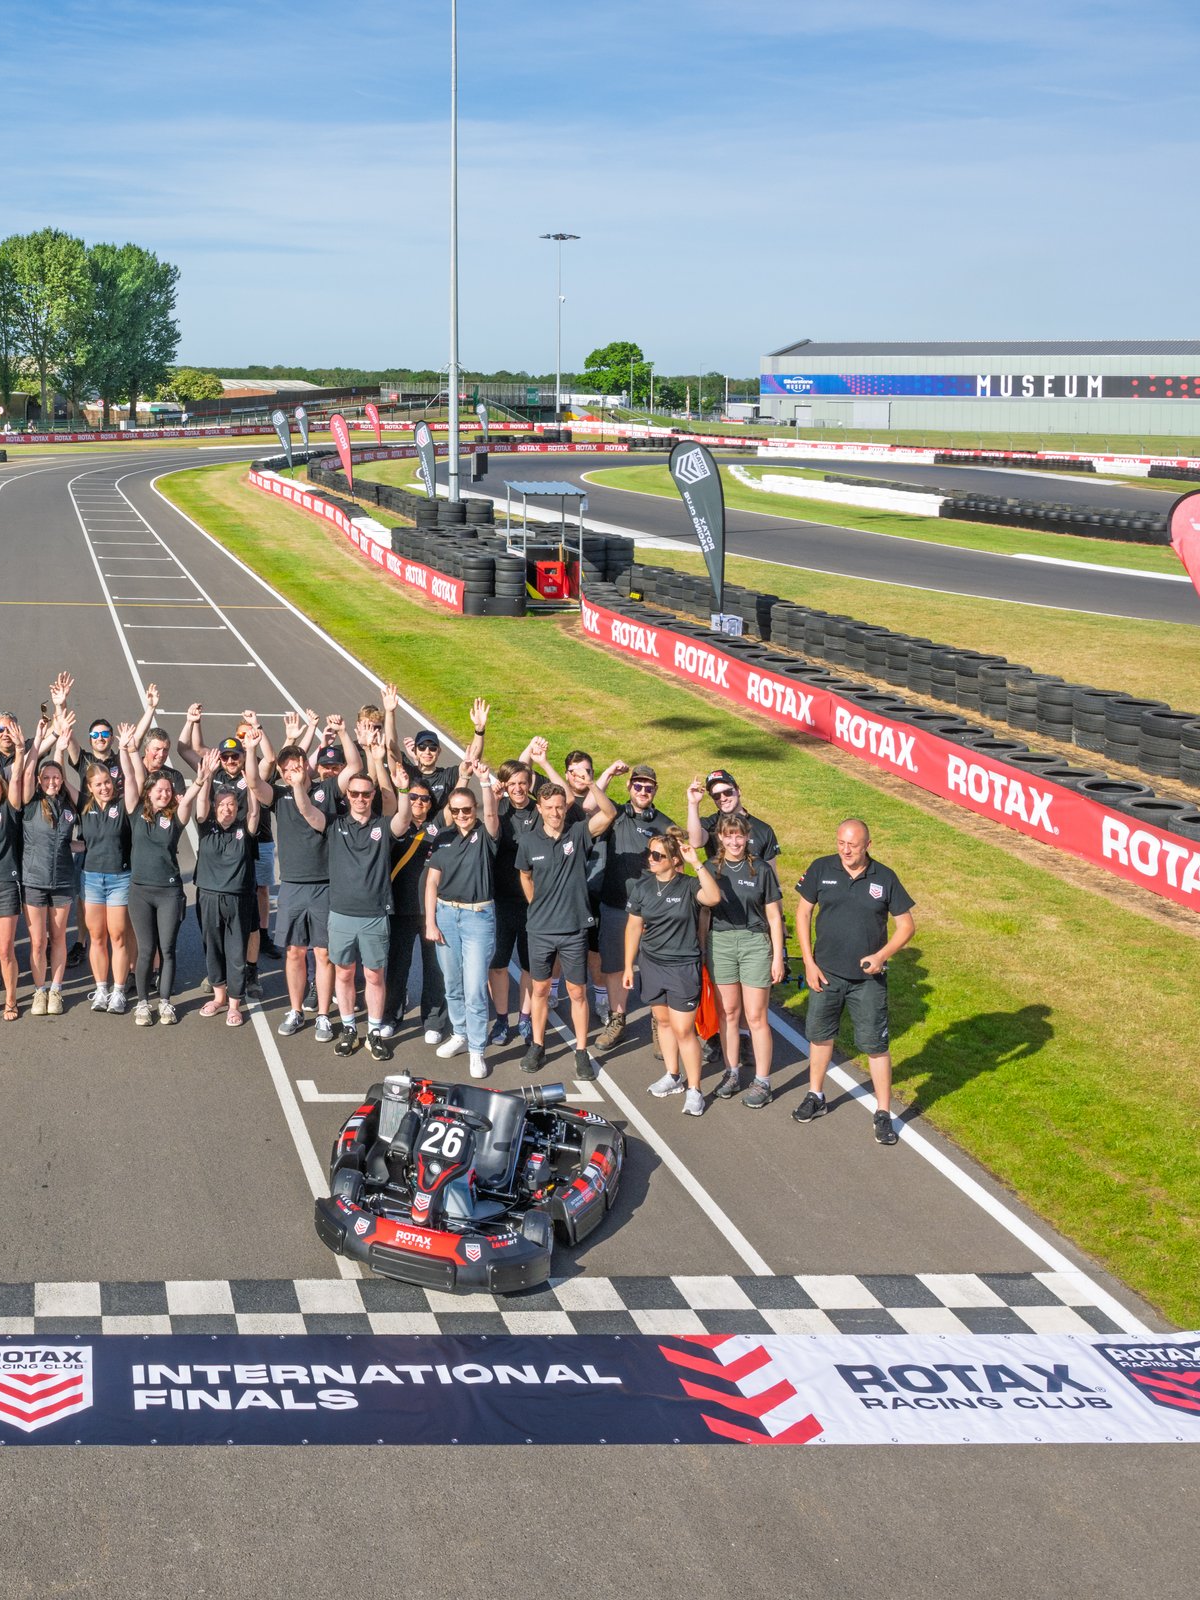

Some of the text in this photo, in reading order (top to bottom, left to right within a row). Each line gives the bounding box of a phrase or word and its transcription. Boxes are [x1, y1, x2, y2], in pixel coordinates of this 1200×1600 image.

[976, 374, 1103, 398] MUSEUM
[517, 444, 540, 452] ROTAX
[547, 444, 569, 452] ROTAX
[604, 444, 628, 452] ROTAX
[700, 436, 719, 444] ROTAX
[1150, 459, 1178, 467] ROTAX
[405, 564, 427, 590] ROTAX
[431, 576, 458, 605] ROTAX
[611, 618, 658, 658] ROTAX
[674, 640, 729, 689] ROTAX
[747, 671, 814, 727] ROTAX
[835, 705, 917, 773] ROTAX
[947, 752, 1055, 834] ROTAX
[420, 1121, 465, 1158] 26
[395, 1229, 433, 1245] ROTAX
[395, 1238, 431, 1249] RACING
[132, 1364, 622, 1385] INTERNATIONAL
[1118, 1360, 1178, 1368] RACING
[833, 1363, 1095, 1394] ROTAX
[134, 1388, 359, 1411] FINALS
[858, 1396, 1113, 1411] RACING CLUB
